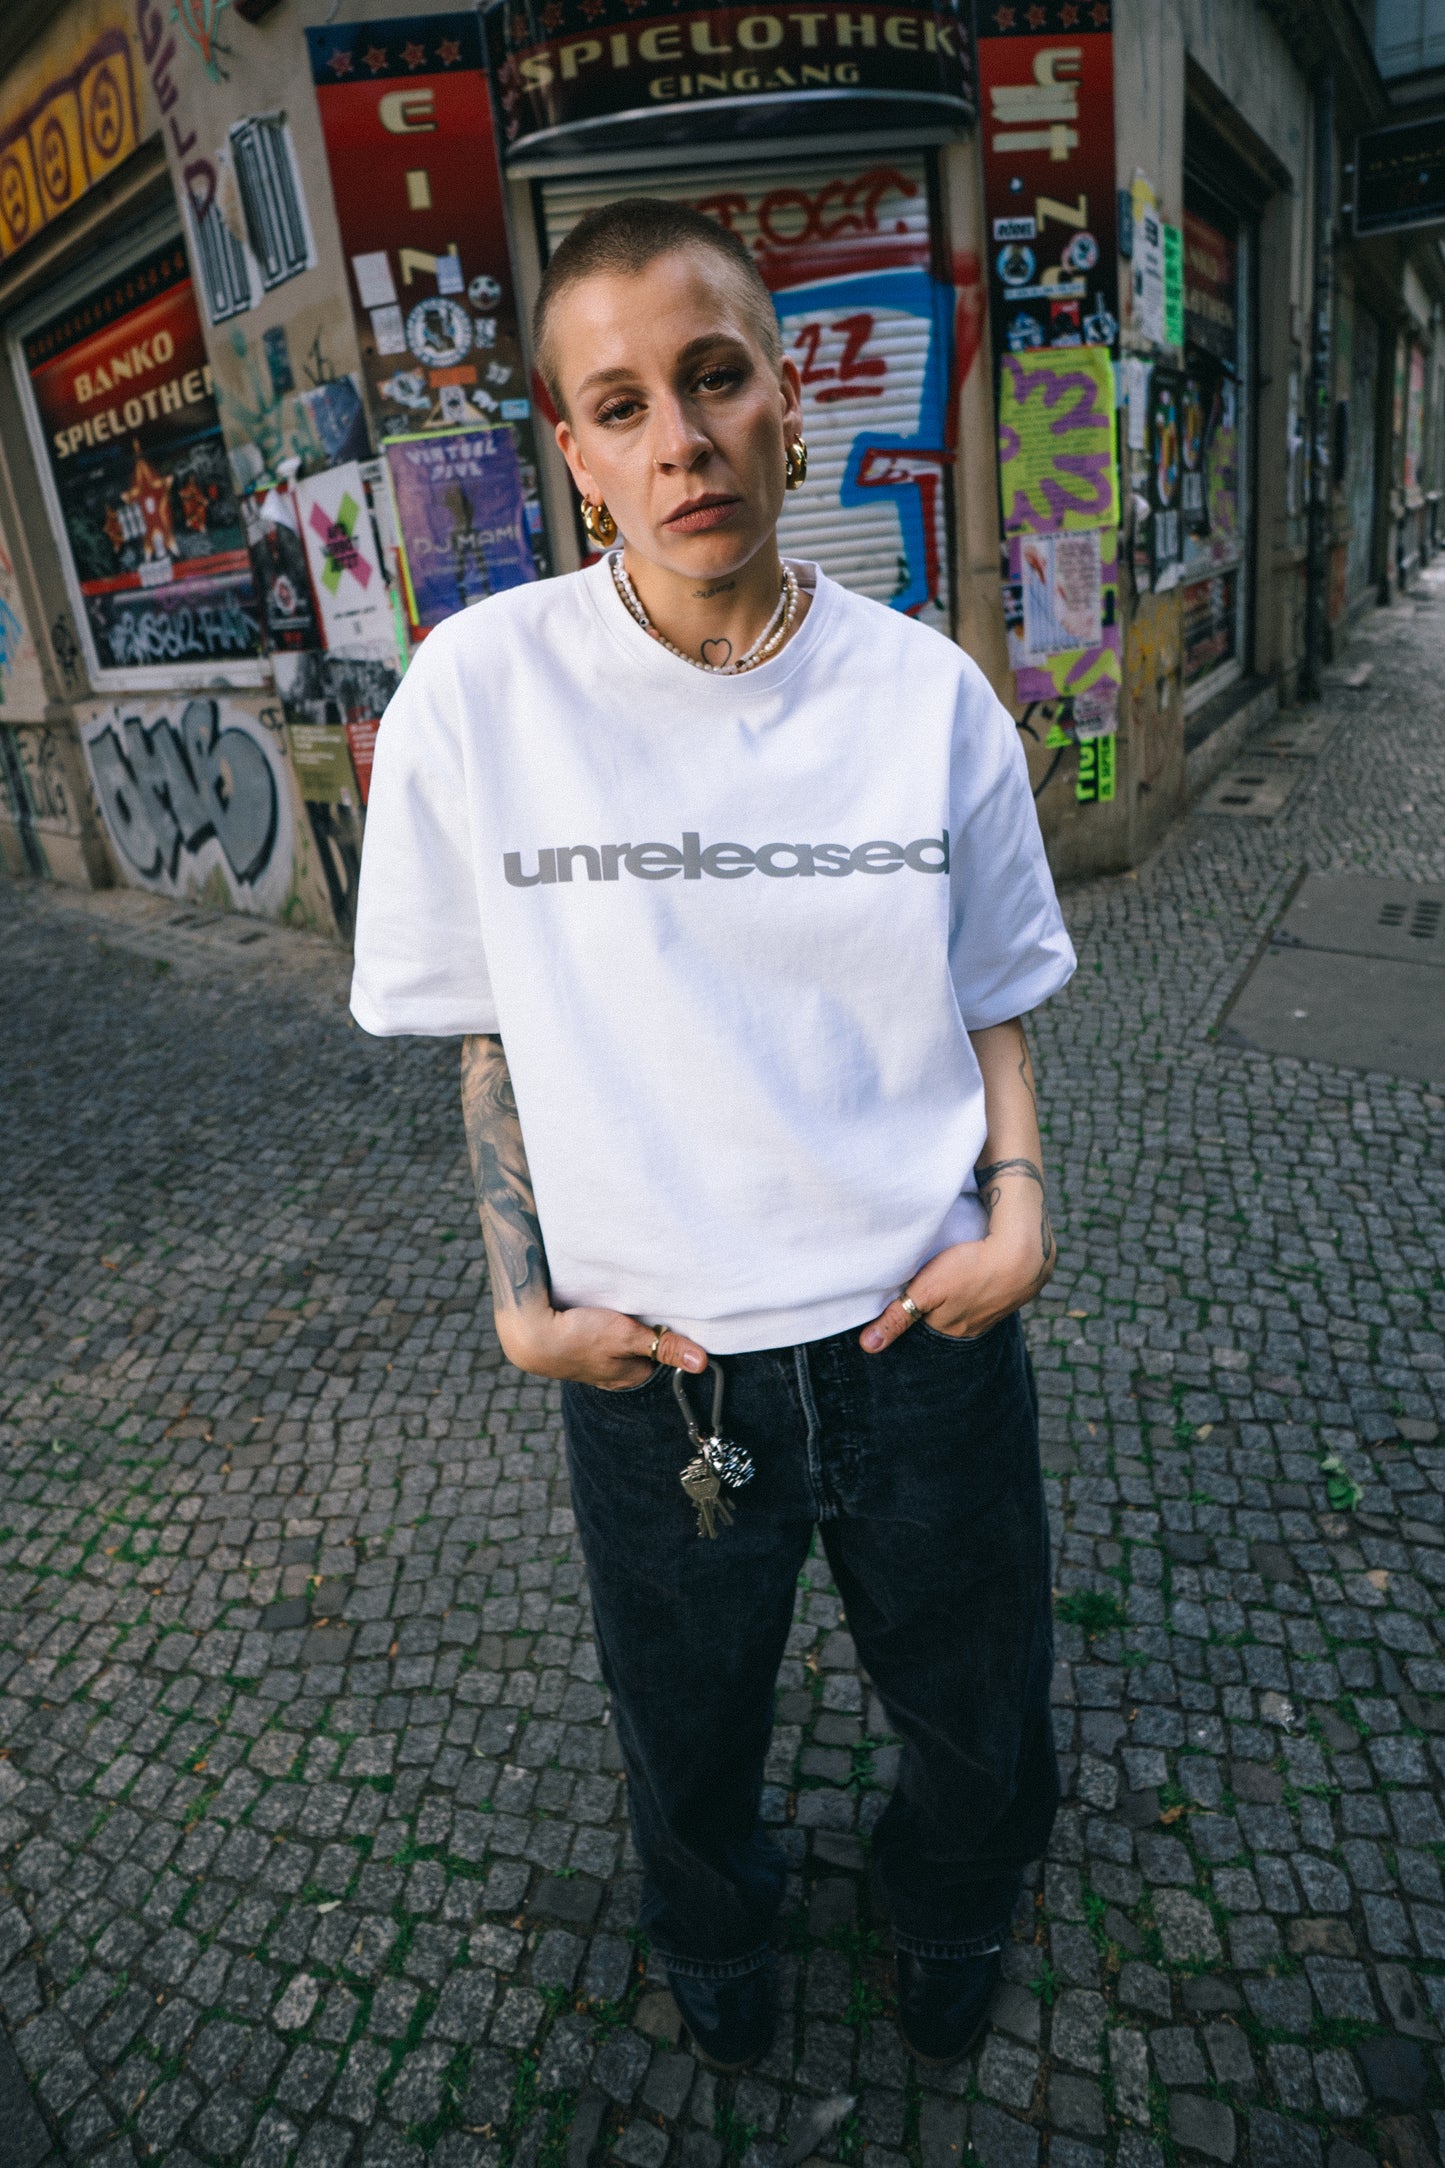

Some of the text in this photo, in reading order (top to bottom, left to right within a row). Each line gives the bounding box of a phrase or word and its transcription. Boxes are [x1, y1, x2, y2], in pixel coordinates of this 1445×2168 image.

[519, 13, 957, 93] SPIELOTHEK
[649, 61, 861, 99] EINGANG
[73, 330, 175, 404] BANKO
[502, 828, 951, 888] unreleased
